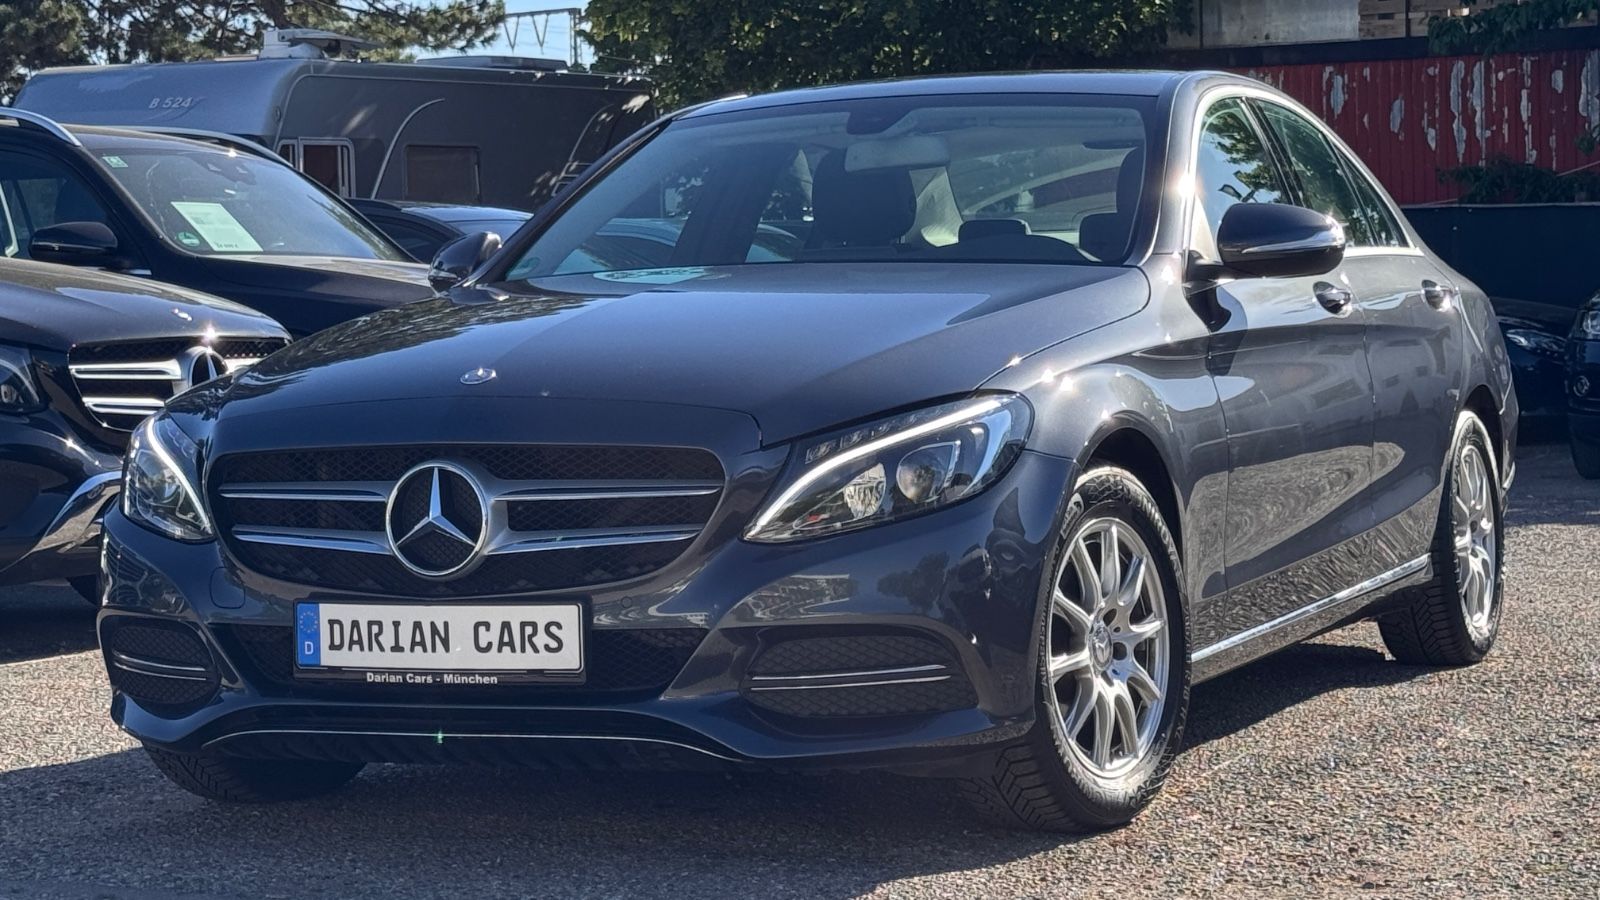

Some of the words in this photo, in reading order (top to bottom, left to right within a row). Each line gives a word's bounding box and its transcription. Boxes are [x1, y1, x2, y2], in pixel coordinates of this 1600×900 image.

[148, 97, 160, 109] B
[162, 97, 193, 109] 524
[328, 619, 450, 653] DARIAN
[473, 621, 564, 653] CARS
[304, 641, 314, 655] D
[366, 672, 403, 683] Darian
[406, 673, 433, 684] Cars
[443, 673, 498, 684] München
